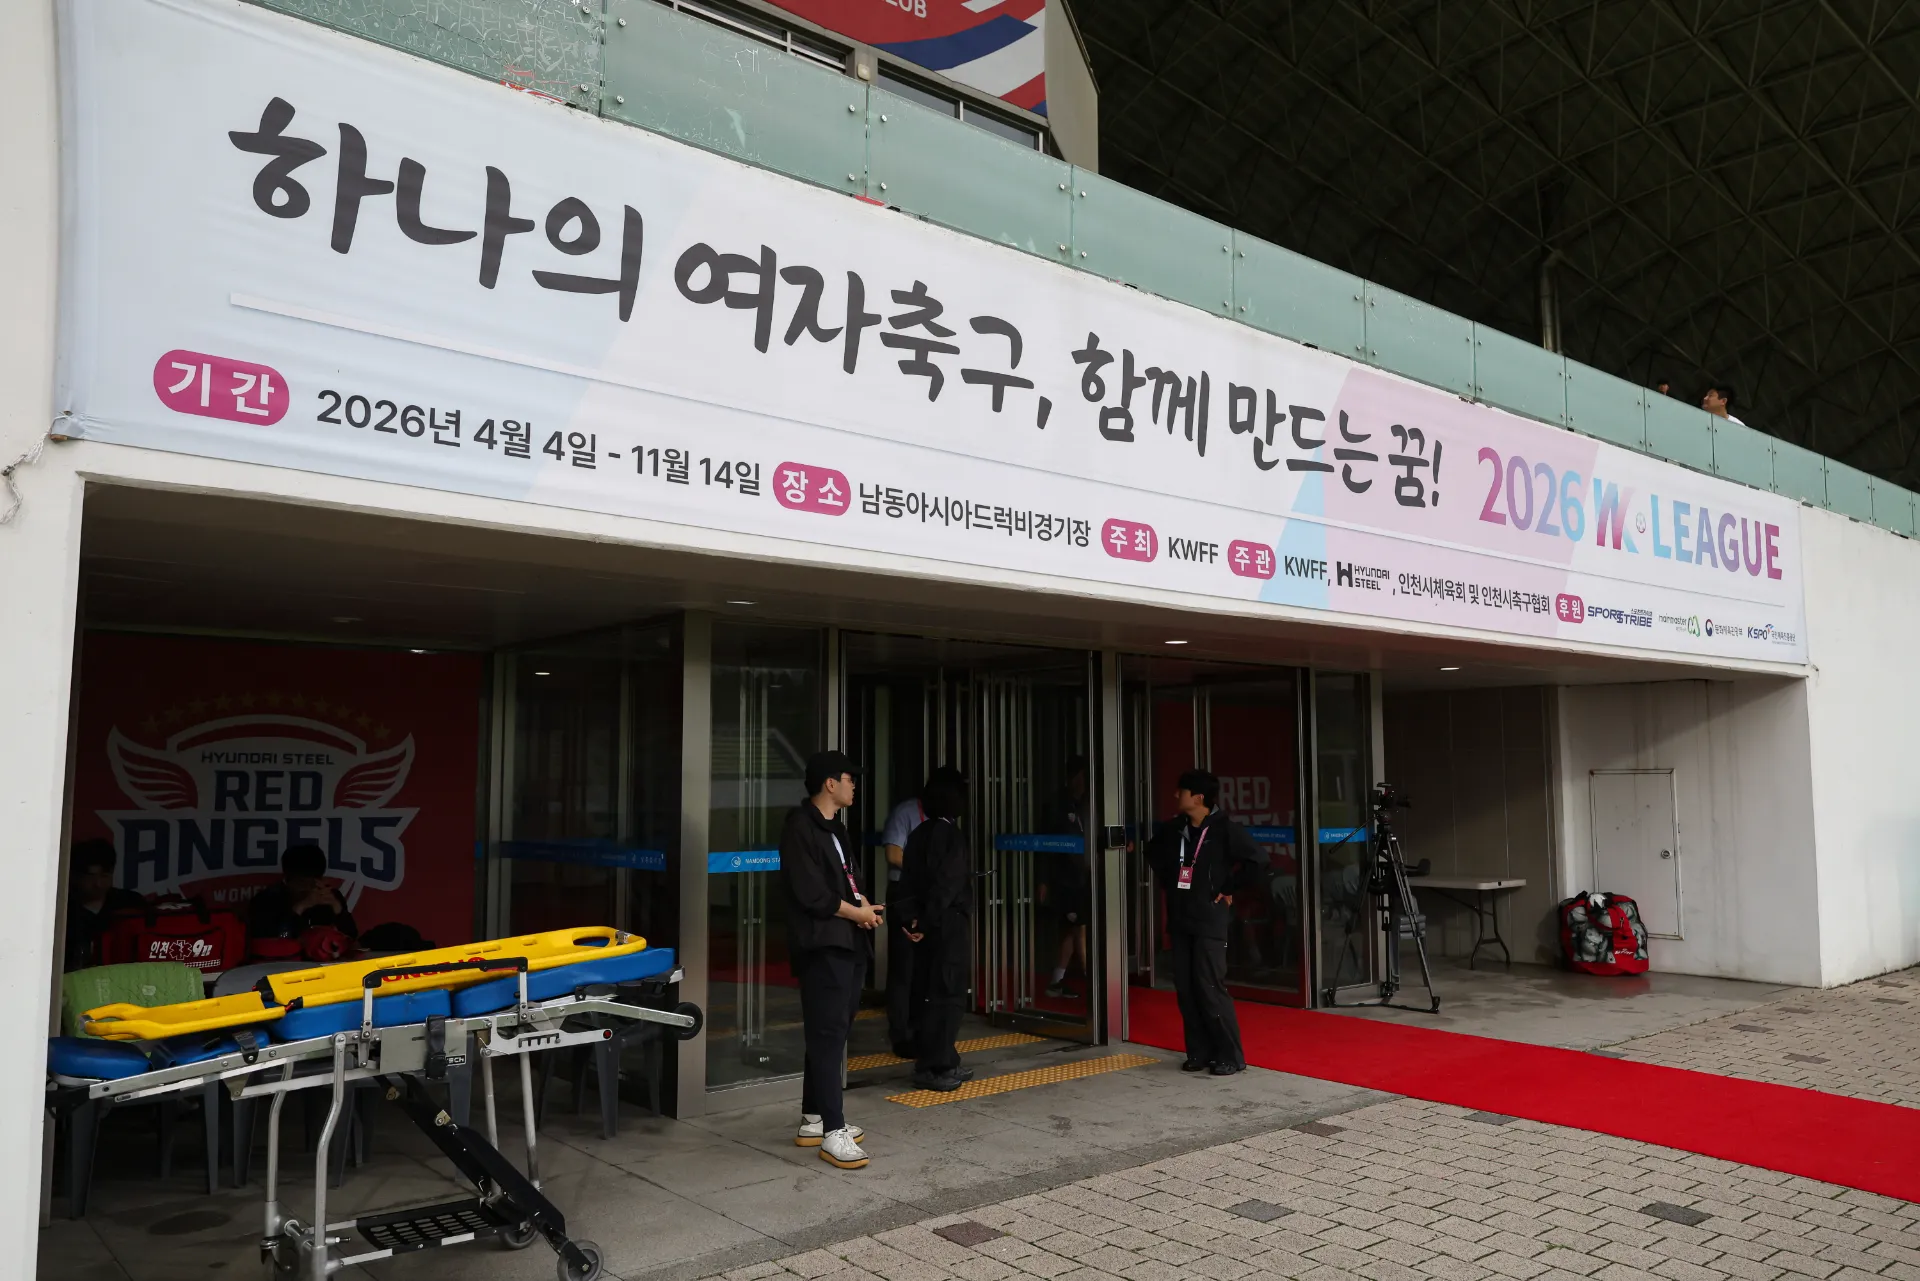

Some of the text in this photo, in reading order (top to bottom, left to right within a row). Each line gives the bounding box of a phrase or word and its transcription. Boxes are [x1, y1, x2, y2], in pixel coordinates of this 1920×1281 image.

[228, 97, 1443, 508] 하나의 여자축구, 함께 만드는 꿈!
[316, 389, 461, 447] 2026년
[473, 418, 531, 459] 4월
[542, 430, 597, 469] 4일
[631, 445, 690, 485] 11월
[699, 457, 761, 496] 14일
[859, 482, 1091, 547] 남동아시아드럭비경기장
[1478, 447, 1585, 542] 2026
[1650, 494, 1783, 580] LEAGUE
[1168, 536, 1219, 564] KWFF
[1284, 555, 1331, 587] KWFF,
[1354, 565, 1390, 580] HYUNDAI
[1355, 577, 1381, 591] STEEL
[1398, 573, 1551, 615] 인천시체육회 및 인천시축구협회
[1747, 626, 1768, 640] KSPO
[201, 752, 335, 765] HYUNDAI STEEL
[214, 770, 323, 812] RED
[1218, 776, 1271, 811] RED
[117, 816, 403, 890] ANGELS
[149, 941, 170, 959] 인천
